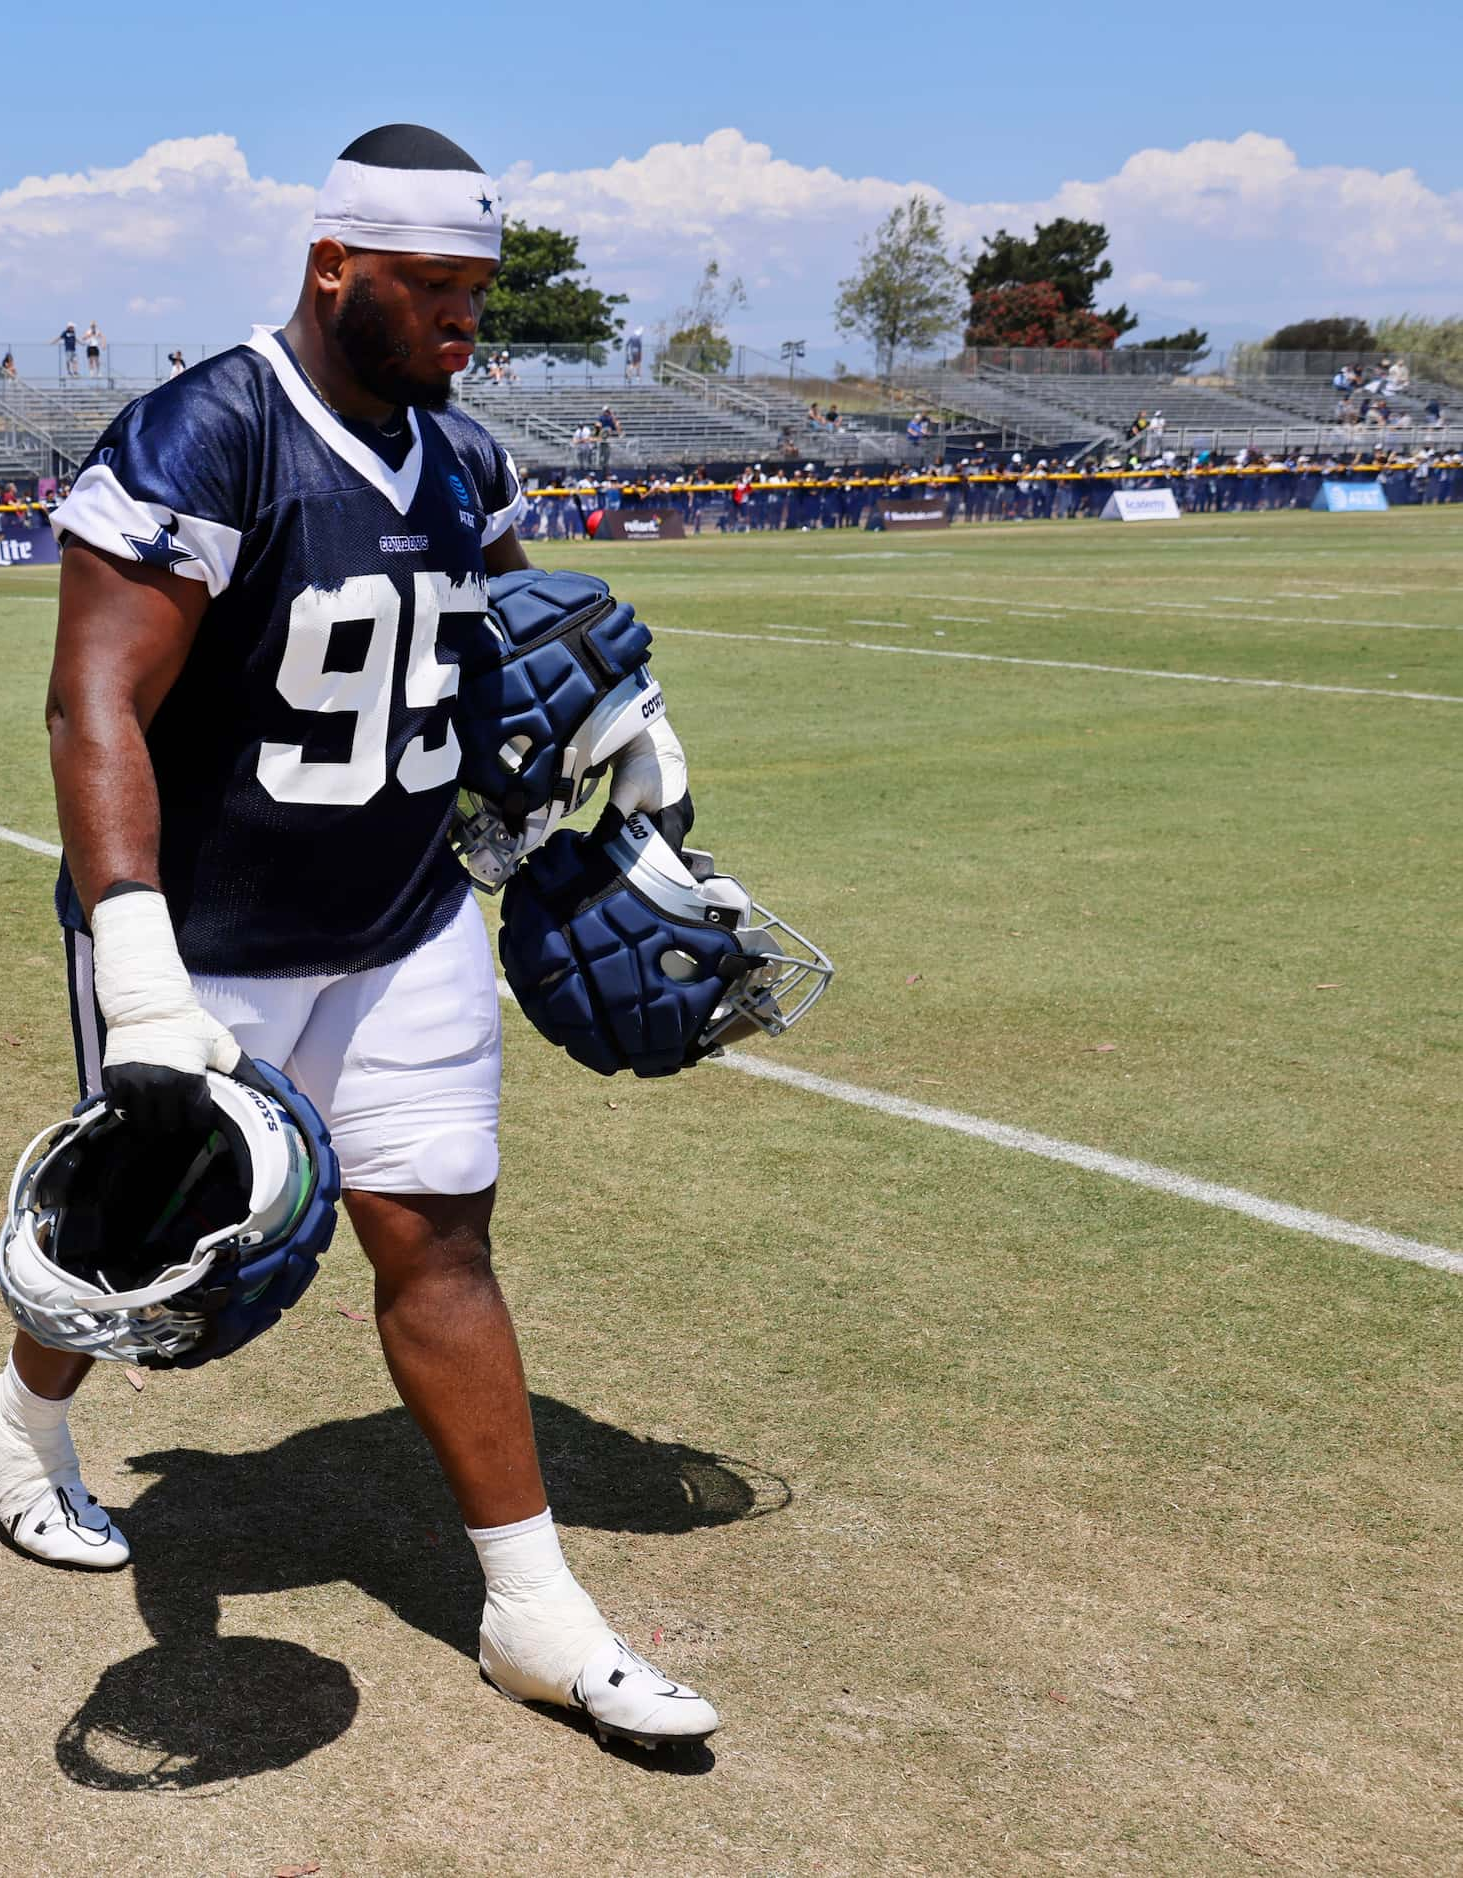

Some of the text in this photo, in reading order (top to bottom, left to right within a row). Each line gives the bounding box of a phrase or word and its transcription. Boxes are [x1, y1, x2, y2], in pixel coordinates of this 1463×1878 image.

[379, 536, 429, 553] COWBOYS
[256, 571, 488, 806] 95
[642, 692, 664, 719] COW
[238, 1083, 279, 1132] BOYS
